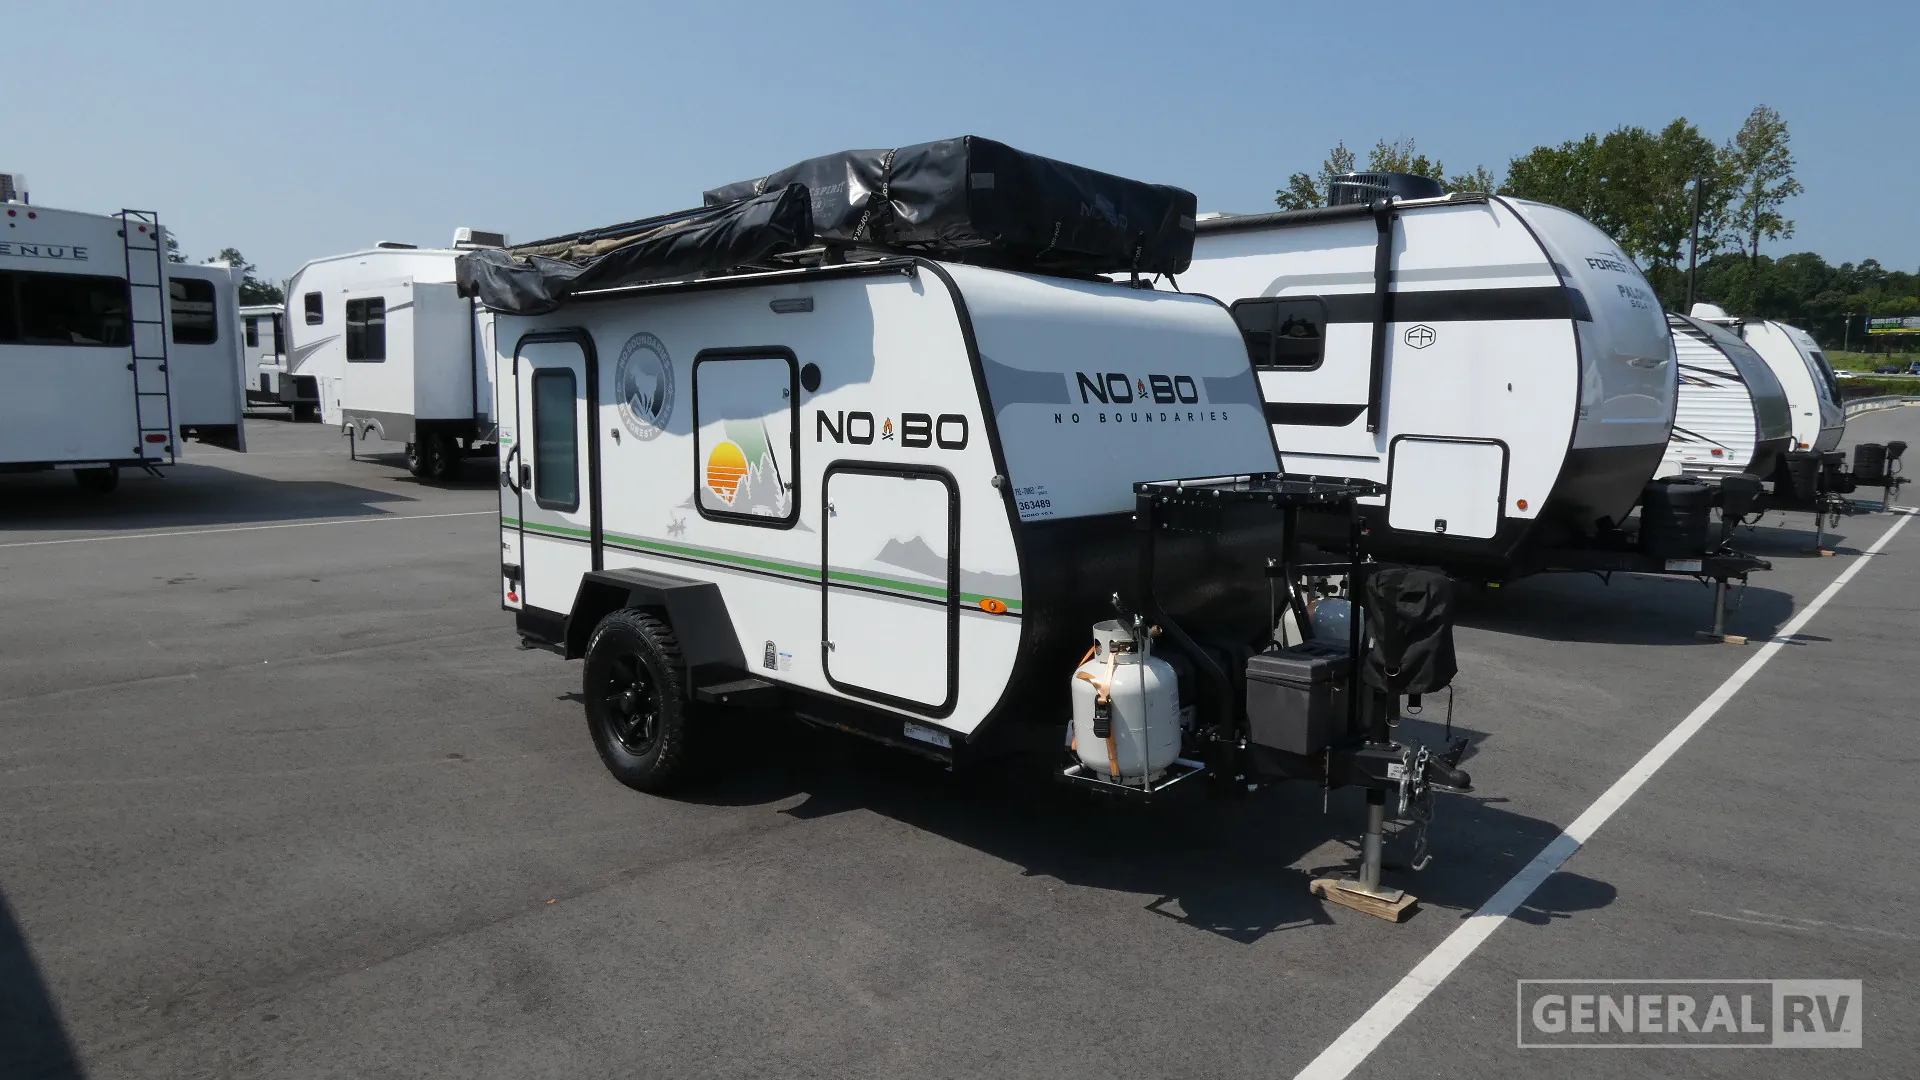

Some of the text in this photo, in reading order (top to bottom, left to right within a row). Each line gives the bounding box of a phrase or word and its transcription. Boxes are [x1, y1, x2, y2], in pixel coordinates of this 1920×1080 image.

[1075, 371, 1199, 404] NO BO
[626, 417, 653, 439] FOREST
[1054, 411, 1228, 424] NO BOUNDARIES
[816, 409, 969, 450] NO BO
[1018, 499, 1051, 511] 363489
